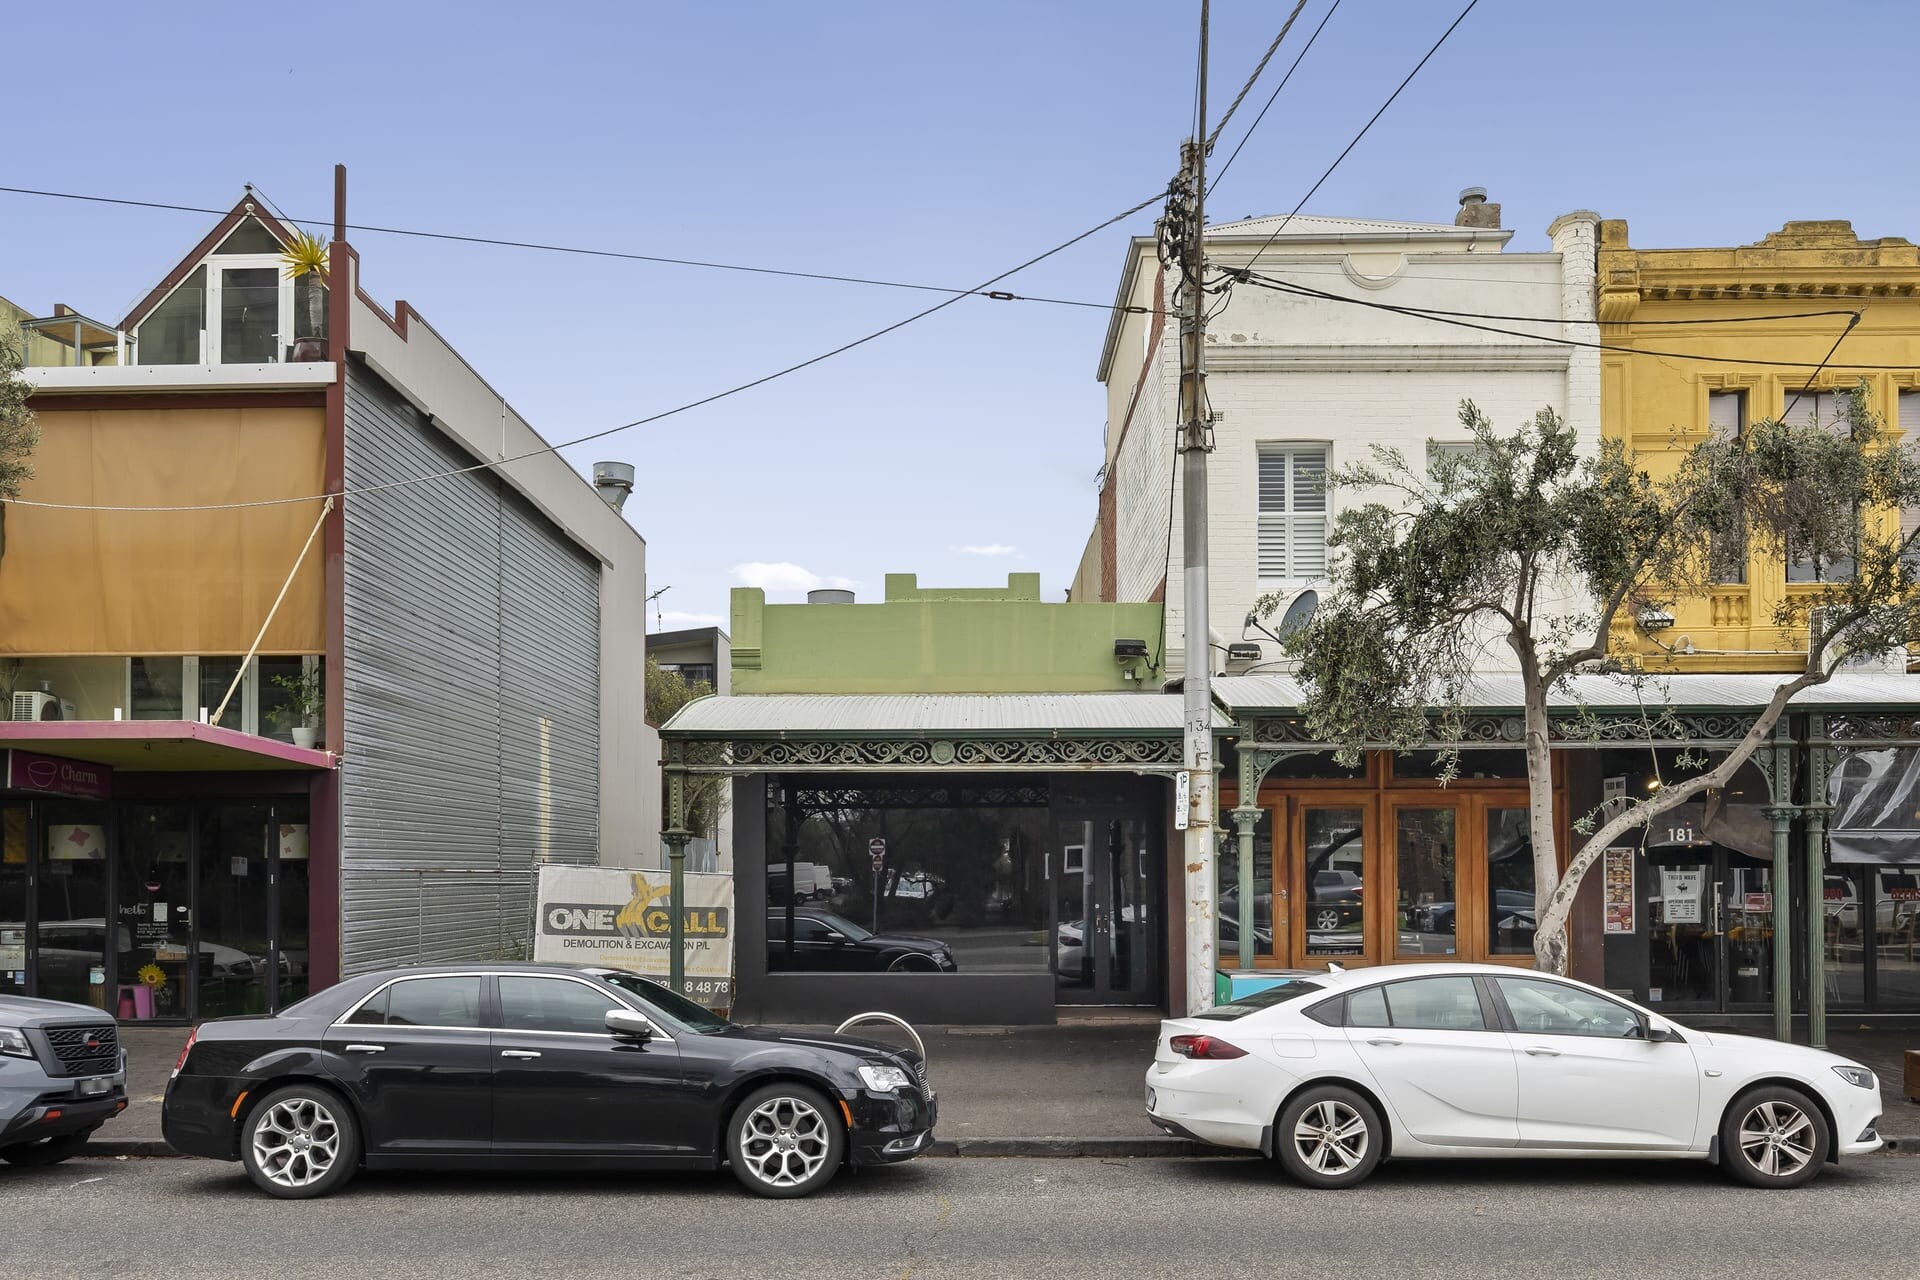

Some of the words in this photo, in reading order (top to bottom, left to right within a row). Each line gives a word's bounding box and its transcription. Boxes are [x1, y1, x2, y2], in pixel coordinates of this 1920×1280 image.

[61, 764, 98, 784] Charm
[1668, 828, 1692, 841] 181
[549, 908, 615, 930] ONE
[563, 939, 623, 949] DEMOLITION
[625, 940, 632, 949] &
[696, 941, 710, 950] P/L
[696, 982, 711, 993] 48
[714, 982, 728, 993] 78
